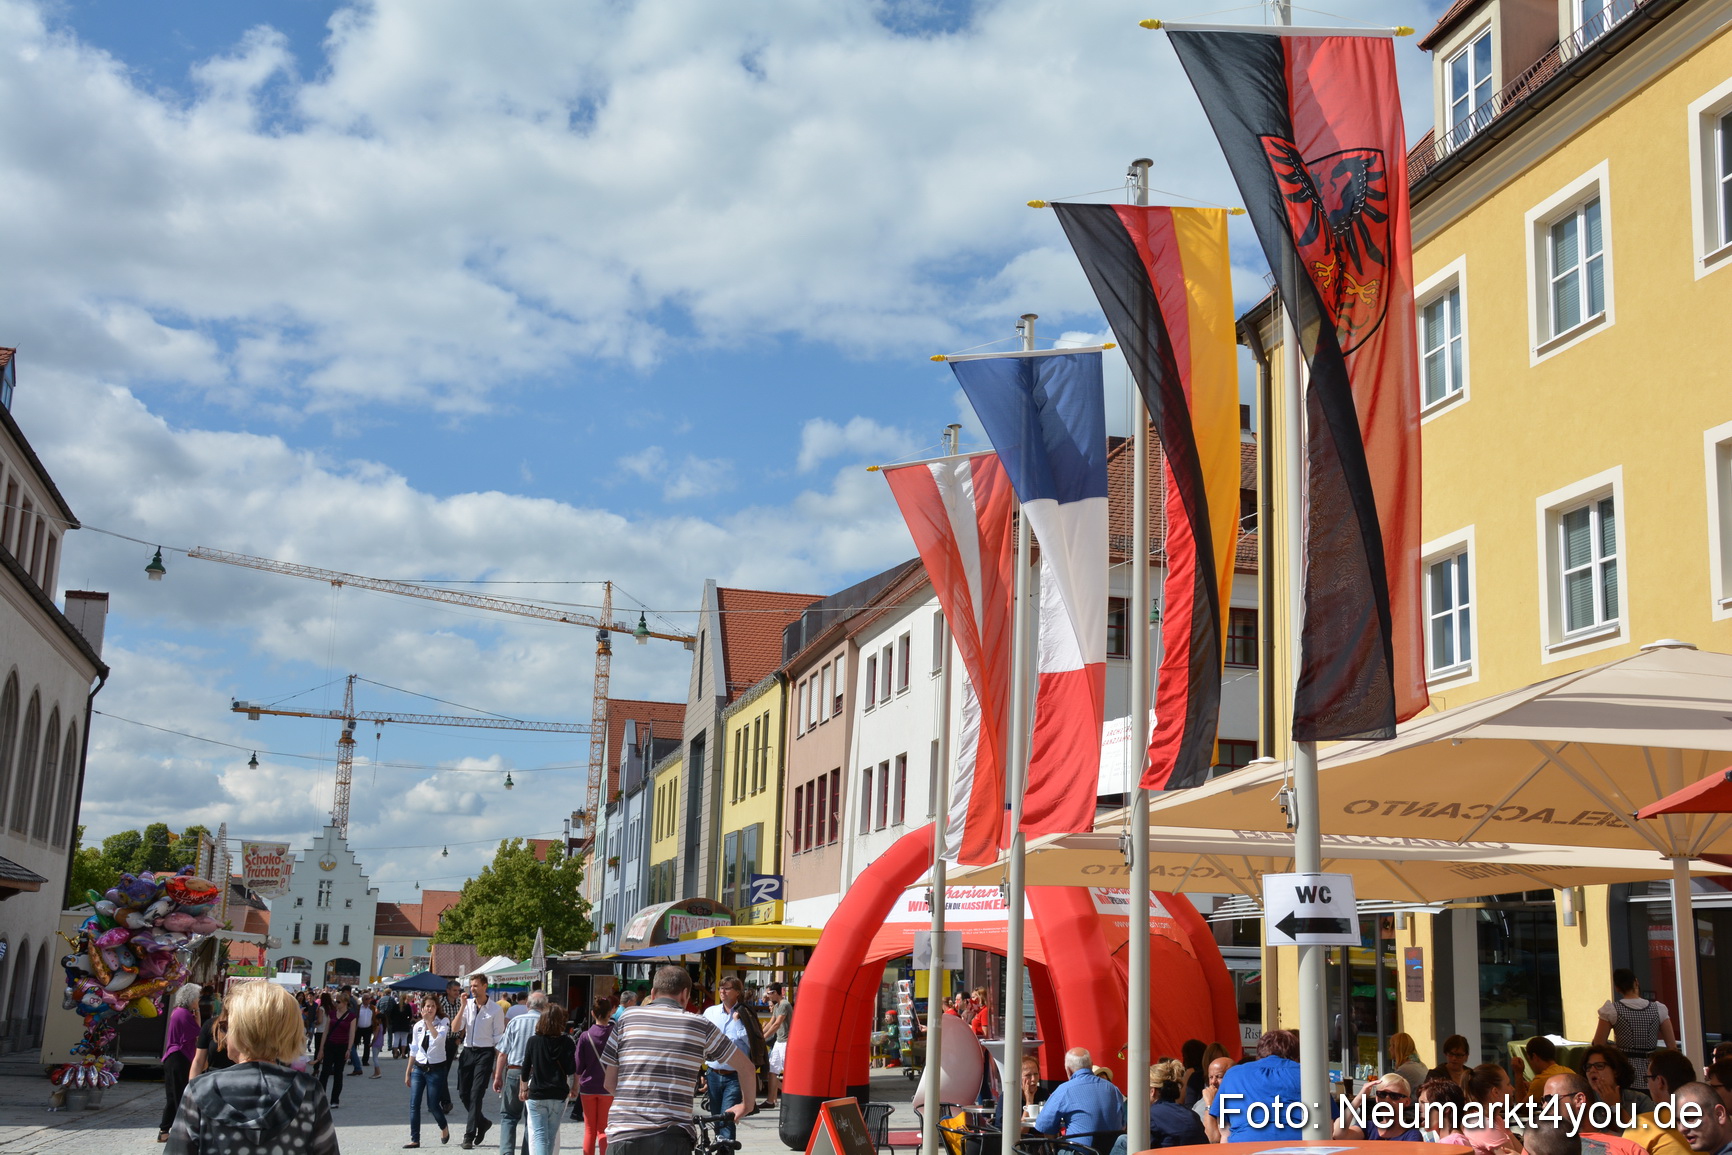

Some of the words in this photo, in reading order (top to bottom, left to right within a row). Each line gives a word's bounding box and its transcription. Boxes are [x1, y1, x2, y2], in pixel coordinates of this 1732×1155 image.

[245, 853, 285, 868] Schoko-
[247, 866, 281, 878] früchte
[752, 878, 779, 903] R
[1295, 886, 1332, 904] WC
